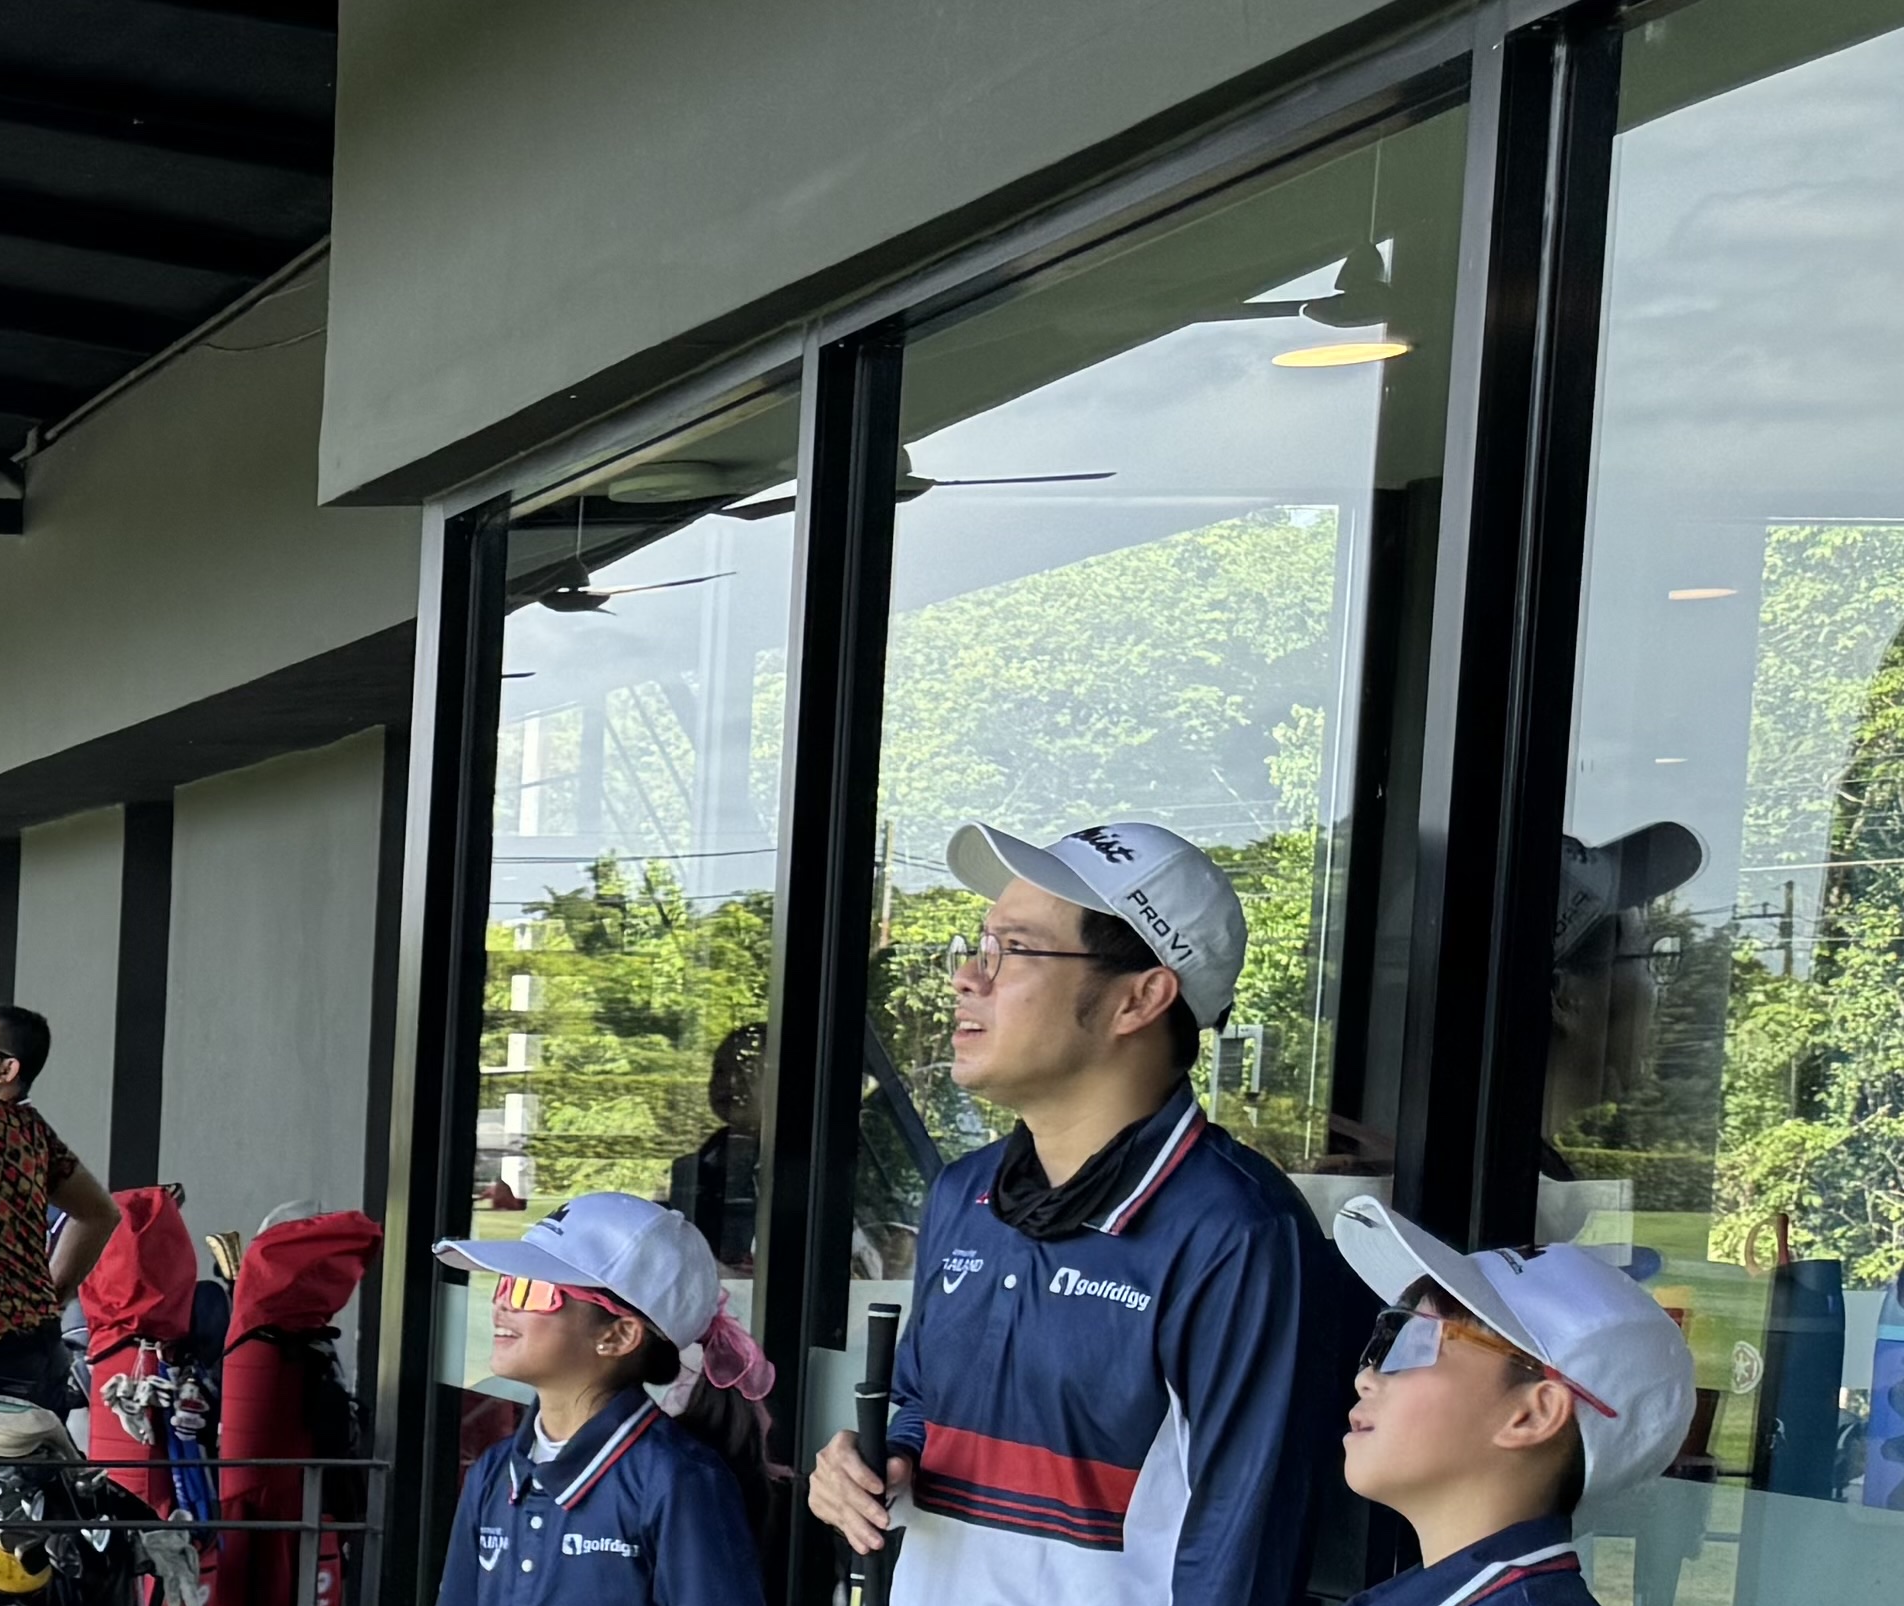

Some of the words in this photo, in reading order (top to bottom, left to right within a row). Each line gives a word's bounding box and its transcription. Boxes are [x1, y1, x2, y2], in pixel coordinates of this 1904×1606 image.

[1126, 889, 1171, 937] PRO
[1170, 932, 1193, 961] V1
[1074, 1279, 1151, 1312] golfdigg
